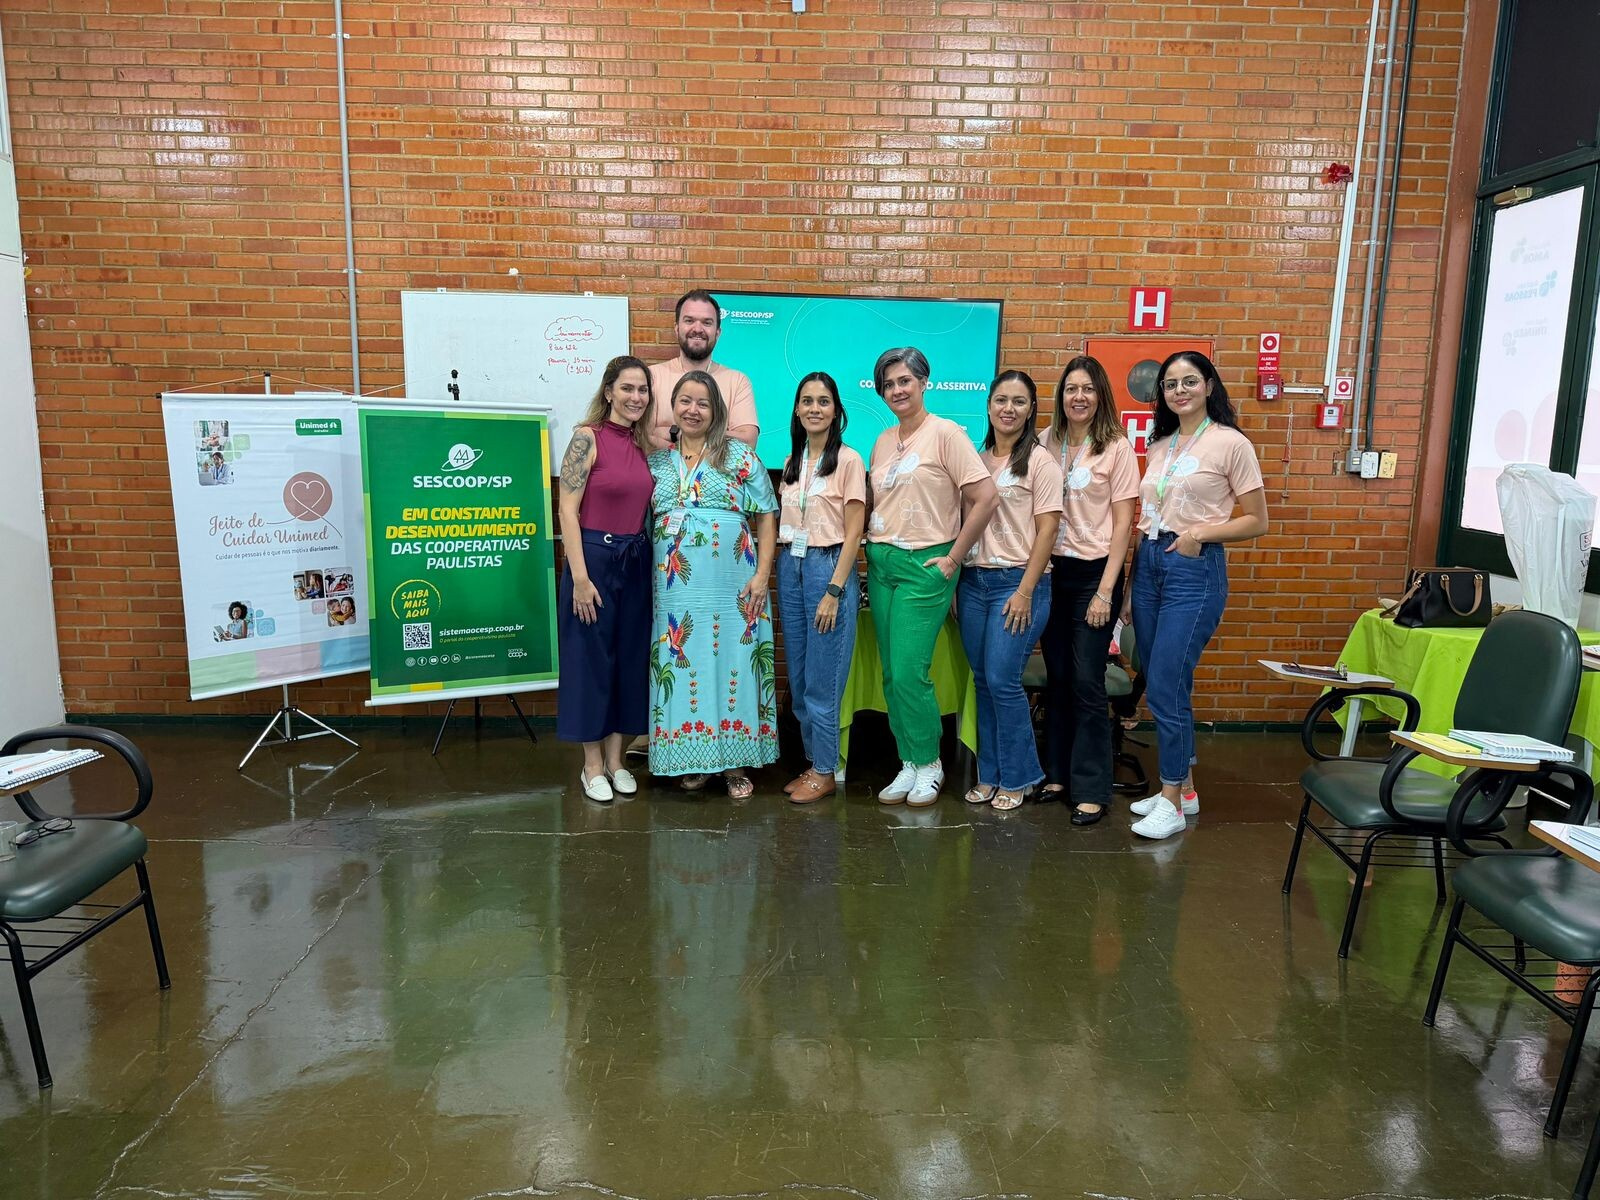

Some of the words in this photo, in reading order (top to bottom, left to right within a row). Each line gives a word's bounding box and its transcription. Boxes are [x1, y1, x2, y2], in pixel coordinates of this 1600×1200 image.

[730, 310, 774, 318] SESCOOP/SP
[1134, 290, 1166, 326] H
[936, 382, 986, 391] ASSERTIVA
[413, 476, 512, 488] SESCOOP/SP
[402, 508, 428, 521] EM
[431, 506, 520, 520] CONSTANTE
[208, 515, 244, 536] Jeito
[248, 512, 265, 527] de
[223, 529, 272, 547] Cuidar
[274, 525, 329, 543] Unimed
[385, 523, 536, 539] DESENVOLVIMENTO
[391, 542, 422, 555] DAS
[425, 539, 530, 554] COOPERATIVAS
[426, 555, 502, 570] PAULISTAS
[401, 589, 429, 600] SAIBA
[404, 599, 427, 609] MAIS
[405, 608, 430, 618] AQUI
[439, 624, 524, 636] sistemaocesp.coop.br
